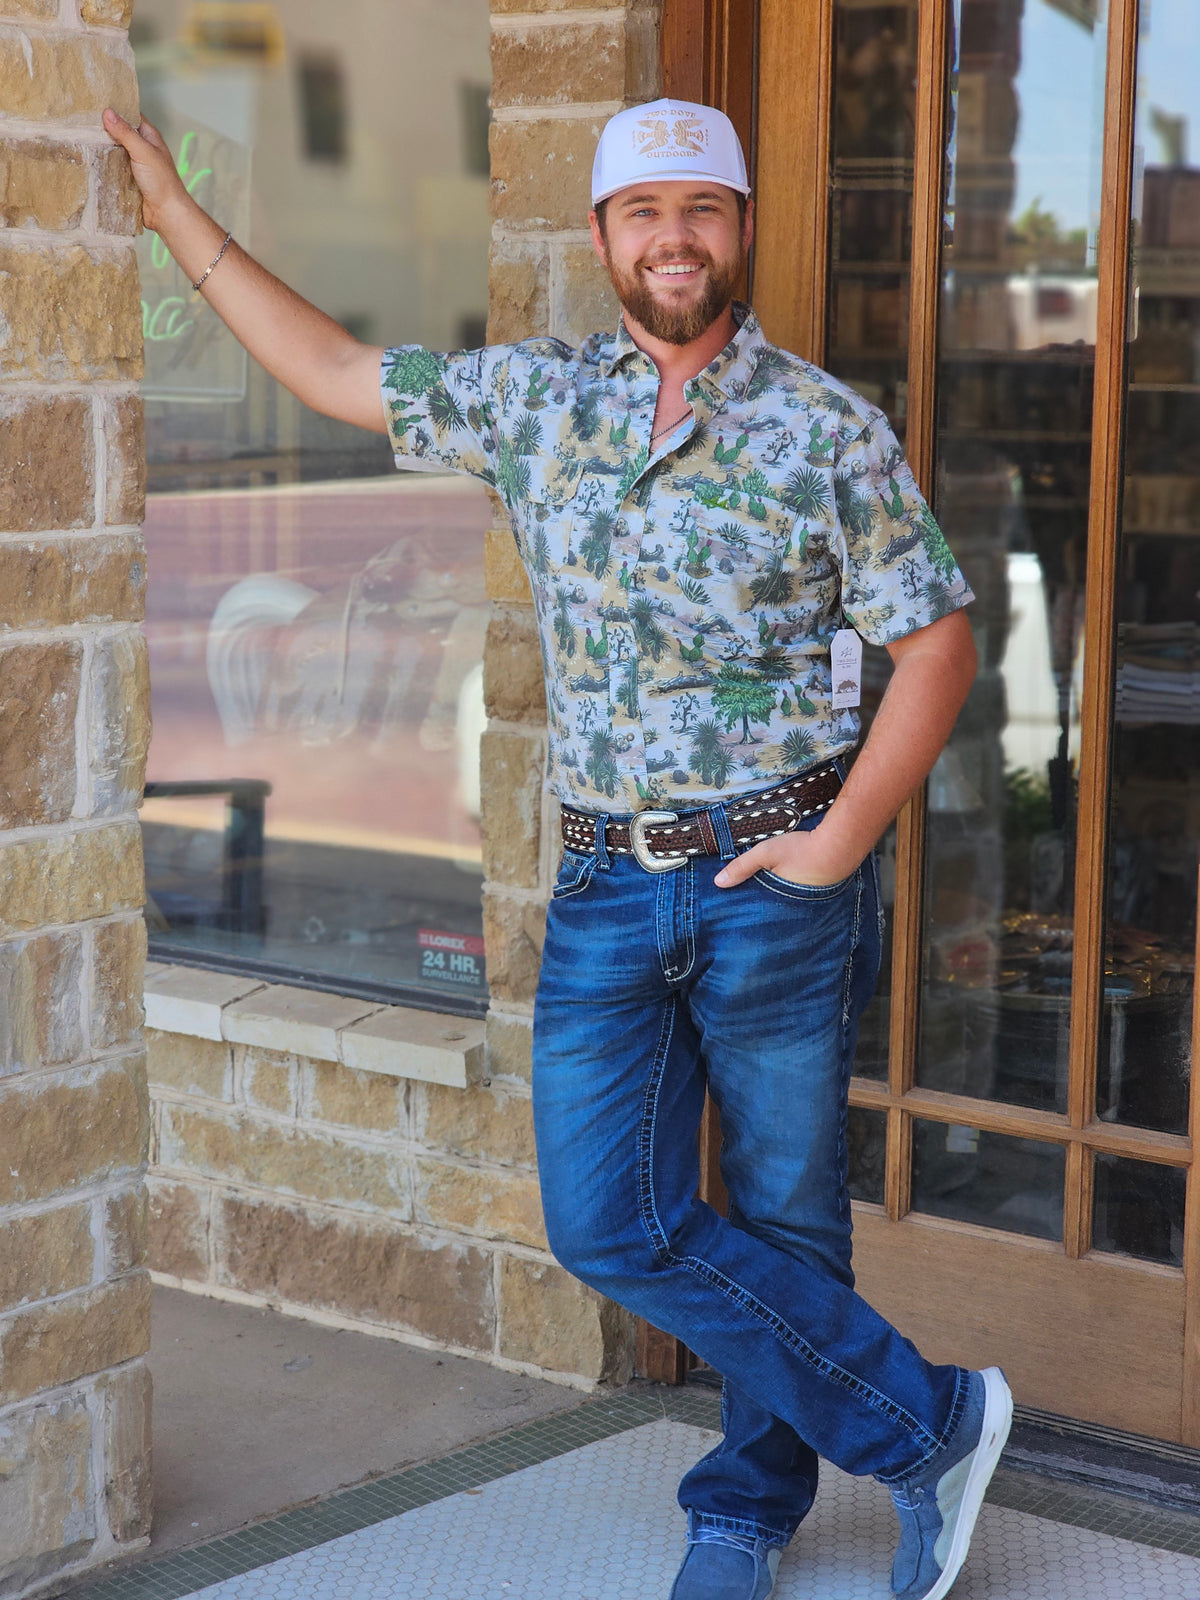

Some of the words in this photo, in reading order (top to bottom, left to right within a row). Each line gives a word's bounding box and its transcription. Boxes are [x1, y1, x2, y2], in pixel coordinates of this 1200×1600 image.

[645, 109, 668, 119] TWO
[670, 109, 696, 119] DOVE
[646, 150, 698, 158] OUTDOORS
[429, 934, 466, 950] LOREX
[423, 950, 445, 969] 24
[450, 953, 480, 974] HR.
[422, 967, 480, 984] SURVEILLANCE
